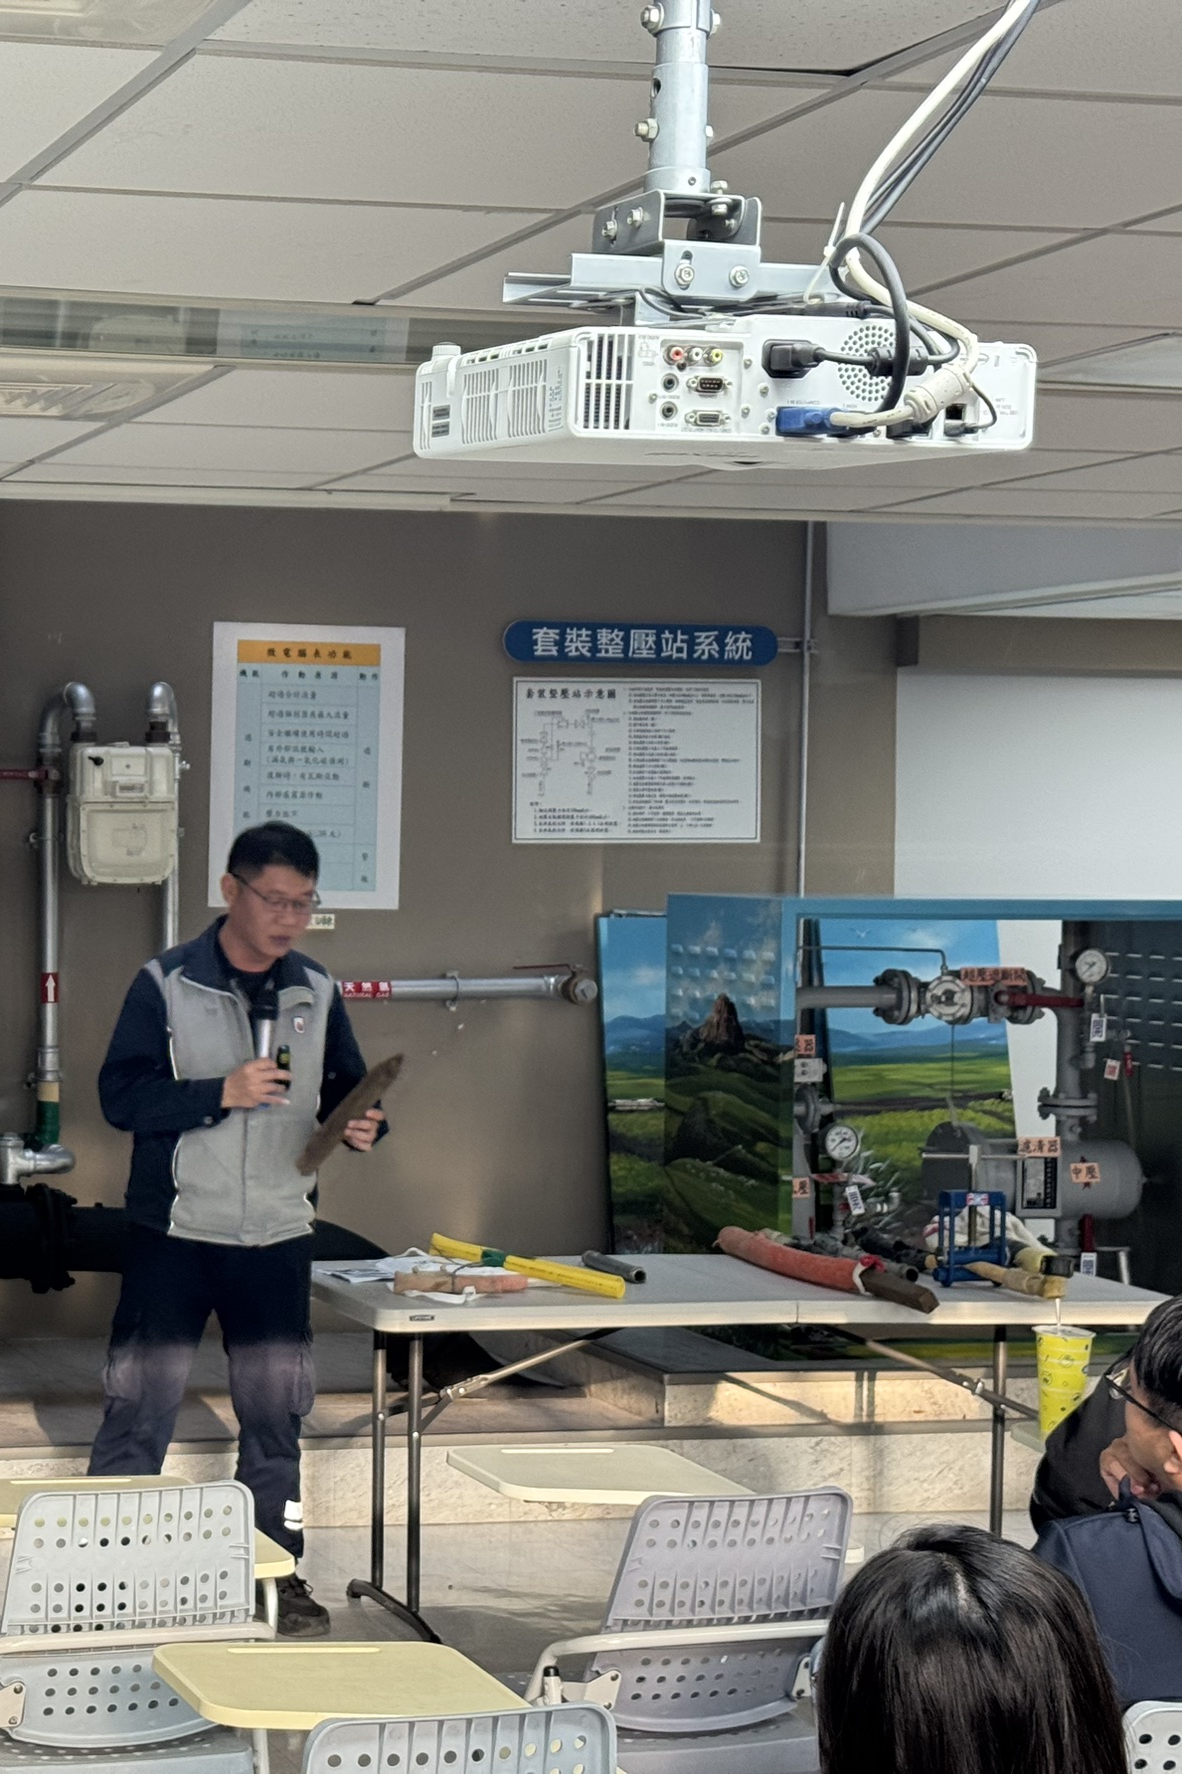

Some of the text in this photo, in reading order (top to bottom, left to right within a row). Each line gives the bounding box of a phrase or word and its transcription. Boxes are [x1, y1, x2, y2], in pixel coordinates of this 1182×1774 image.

[532, 627, 753, 660] 套裝整壓站系統
[526, 687, 616, 699] 套裝整壓站示意圖
[344, 981, 390, 992] 天然氣
[1072, 1164, 1099, 1180] 中壓
